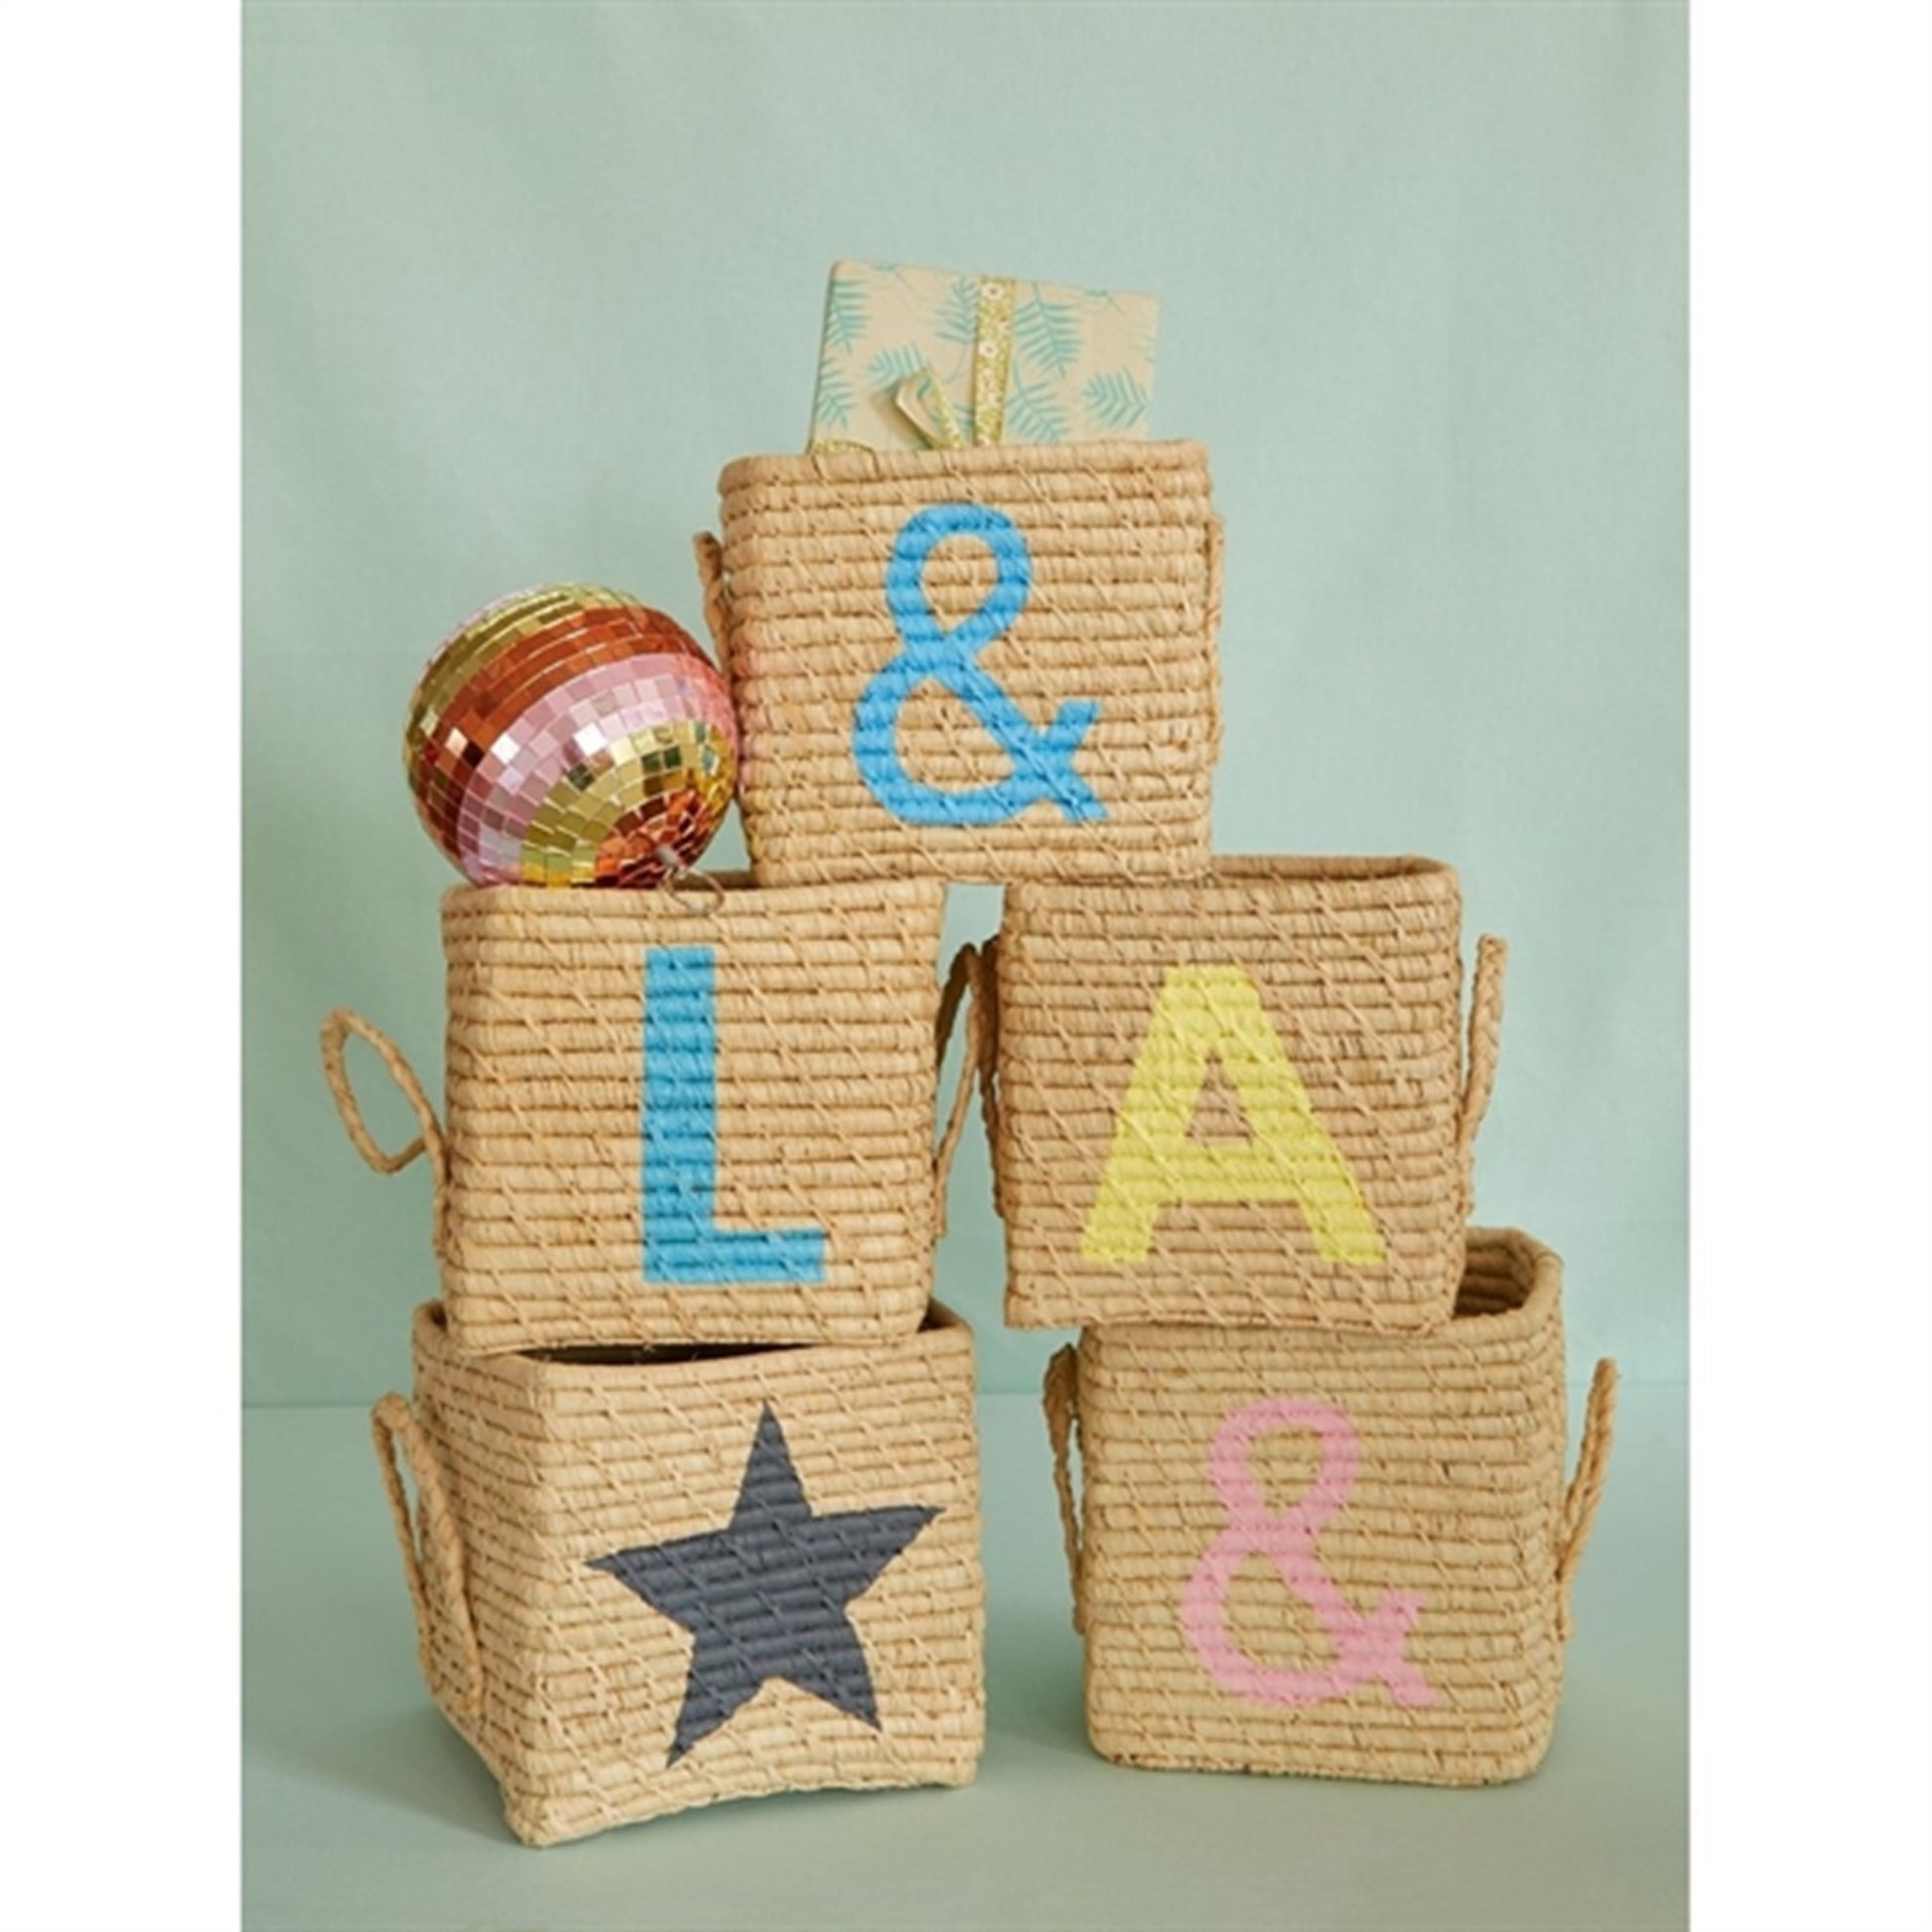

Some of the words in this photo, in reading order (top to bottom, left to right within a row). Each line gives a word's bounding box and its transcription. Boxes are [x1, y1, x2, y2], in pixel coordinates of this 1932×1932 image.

[852, 502, 1109, 826] &
[641, 946, 826, 1285] L
[1082, 964, 1382, 1264] A
[1180, 1395, 1440, 1709] &
